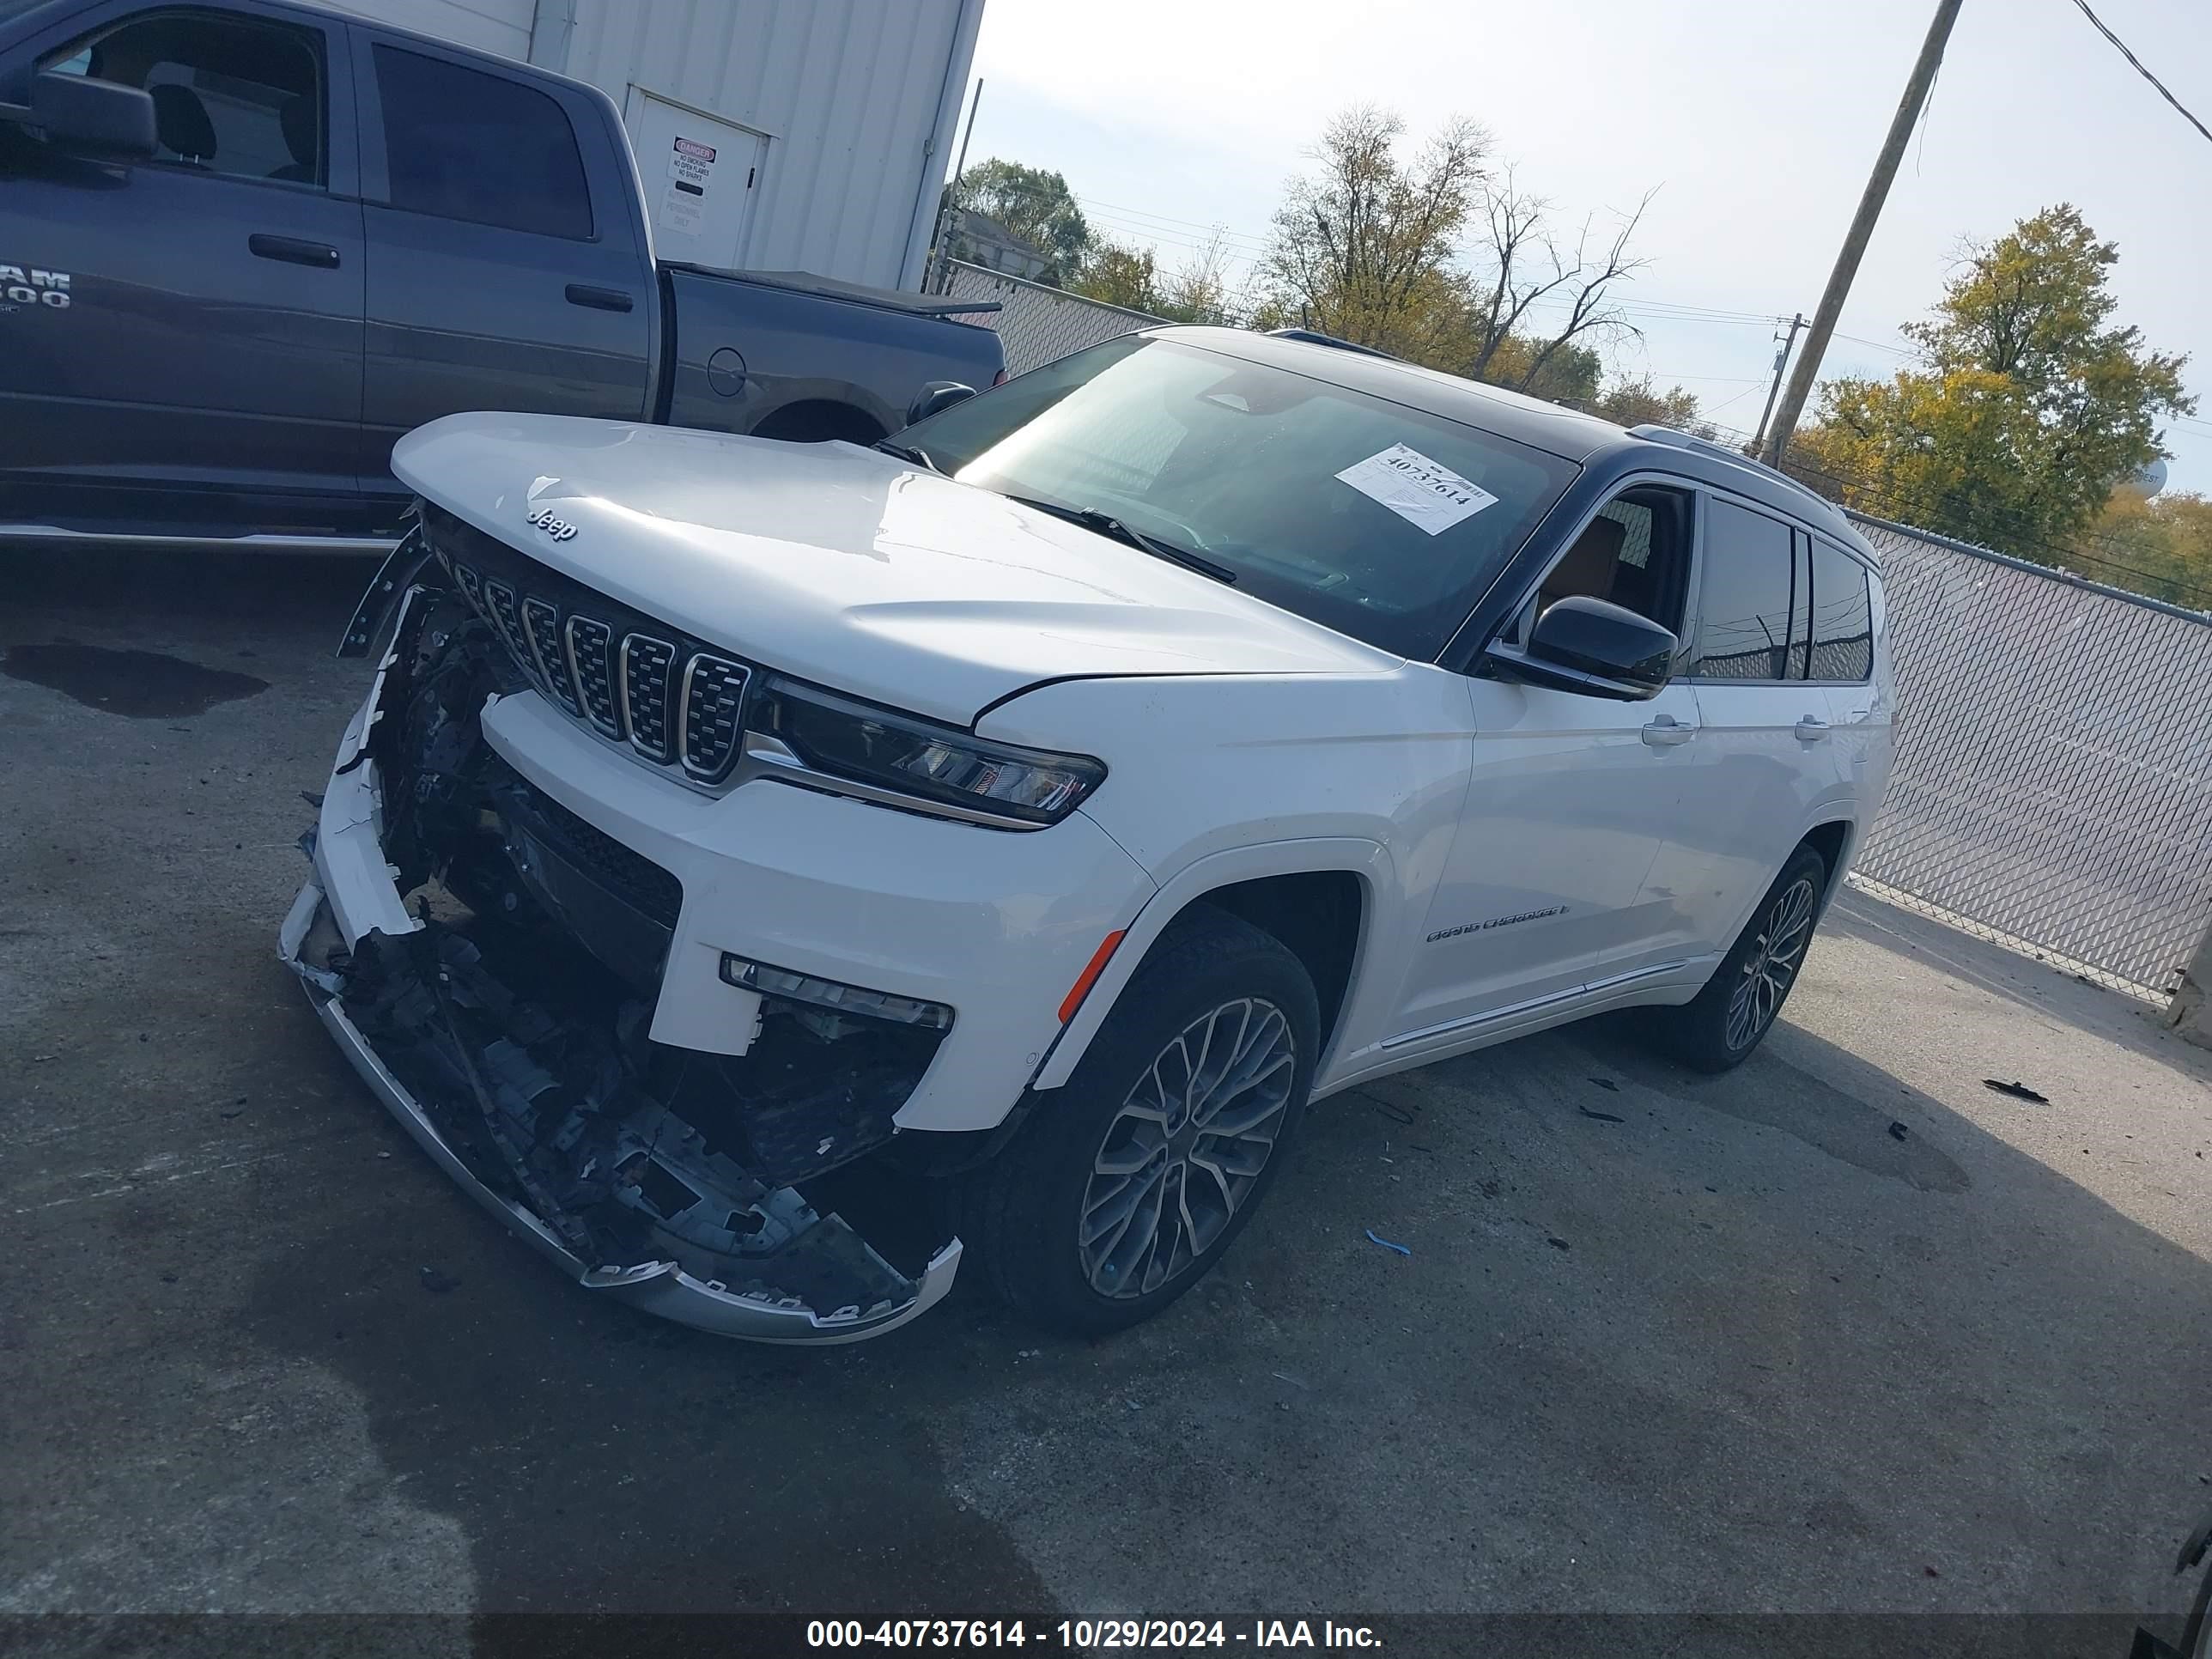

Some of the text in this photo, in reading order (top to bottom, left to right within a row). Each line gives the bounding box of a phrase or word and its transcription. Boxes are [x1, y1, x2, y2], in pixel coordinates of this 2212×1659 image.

[680, 142, 709, 158] DANGER
[687, 157, 707, 167] SMOKING
[680, 162, 693, 171] OPEN
[693, 165, 709, 177] FLAMES
[685, 171, 702, 181] SPARKS
[0, 264, 70, 289] AM
[0, 283, 70, 309] 00
[1387, 457, 1471, 505] 40737614
[526, 507, 579, 542] Jeep
[1426, 922, 1480, 942] GRAND
[1483, 907, 1559, 929] CHEROKEE
